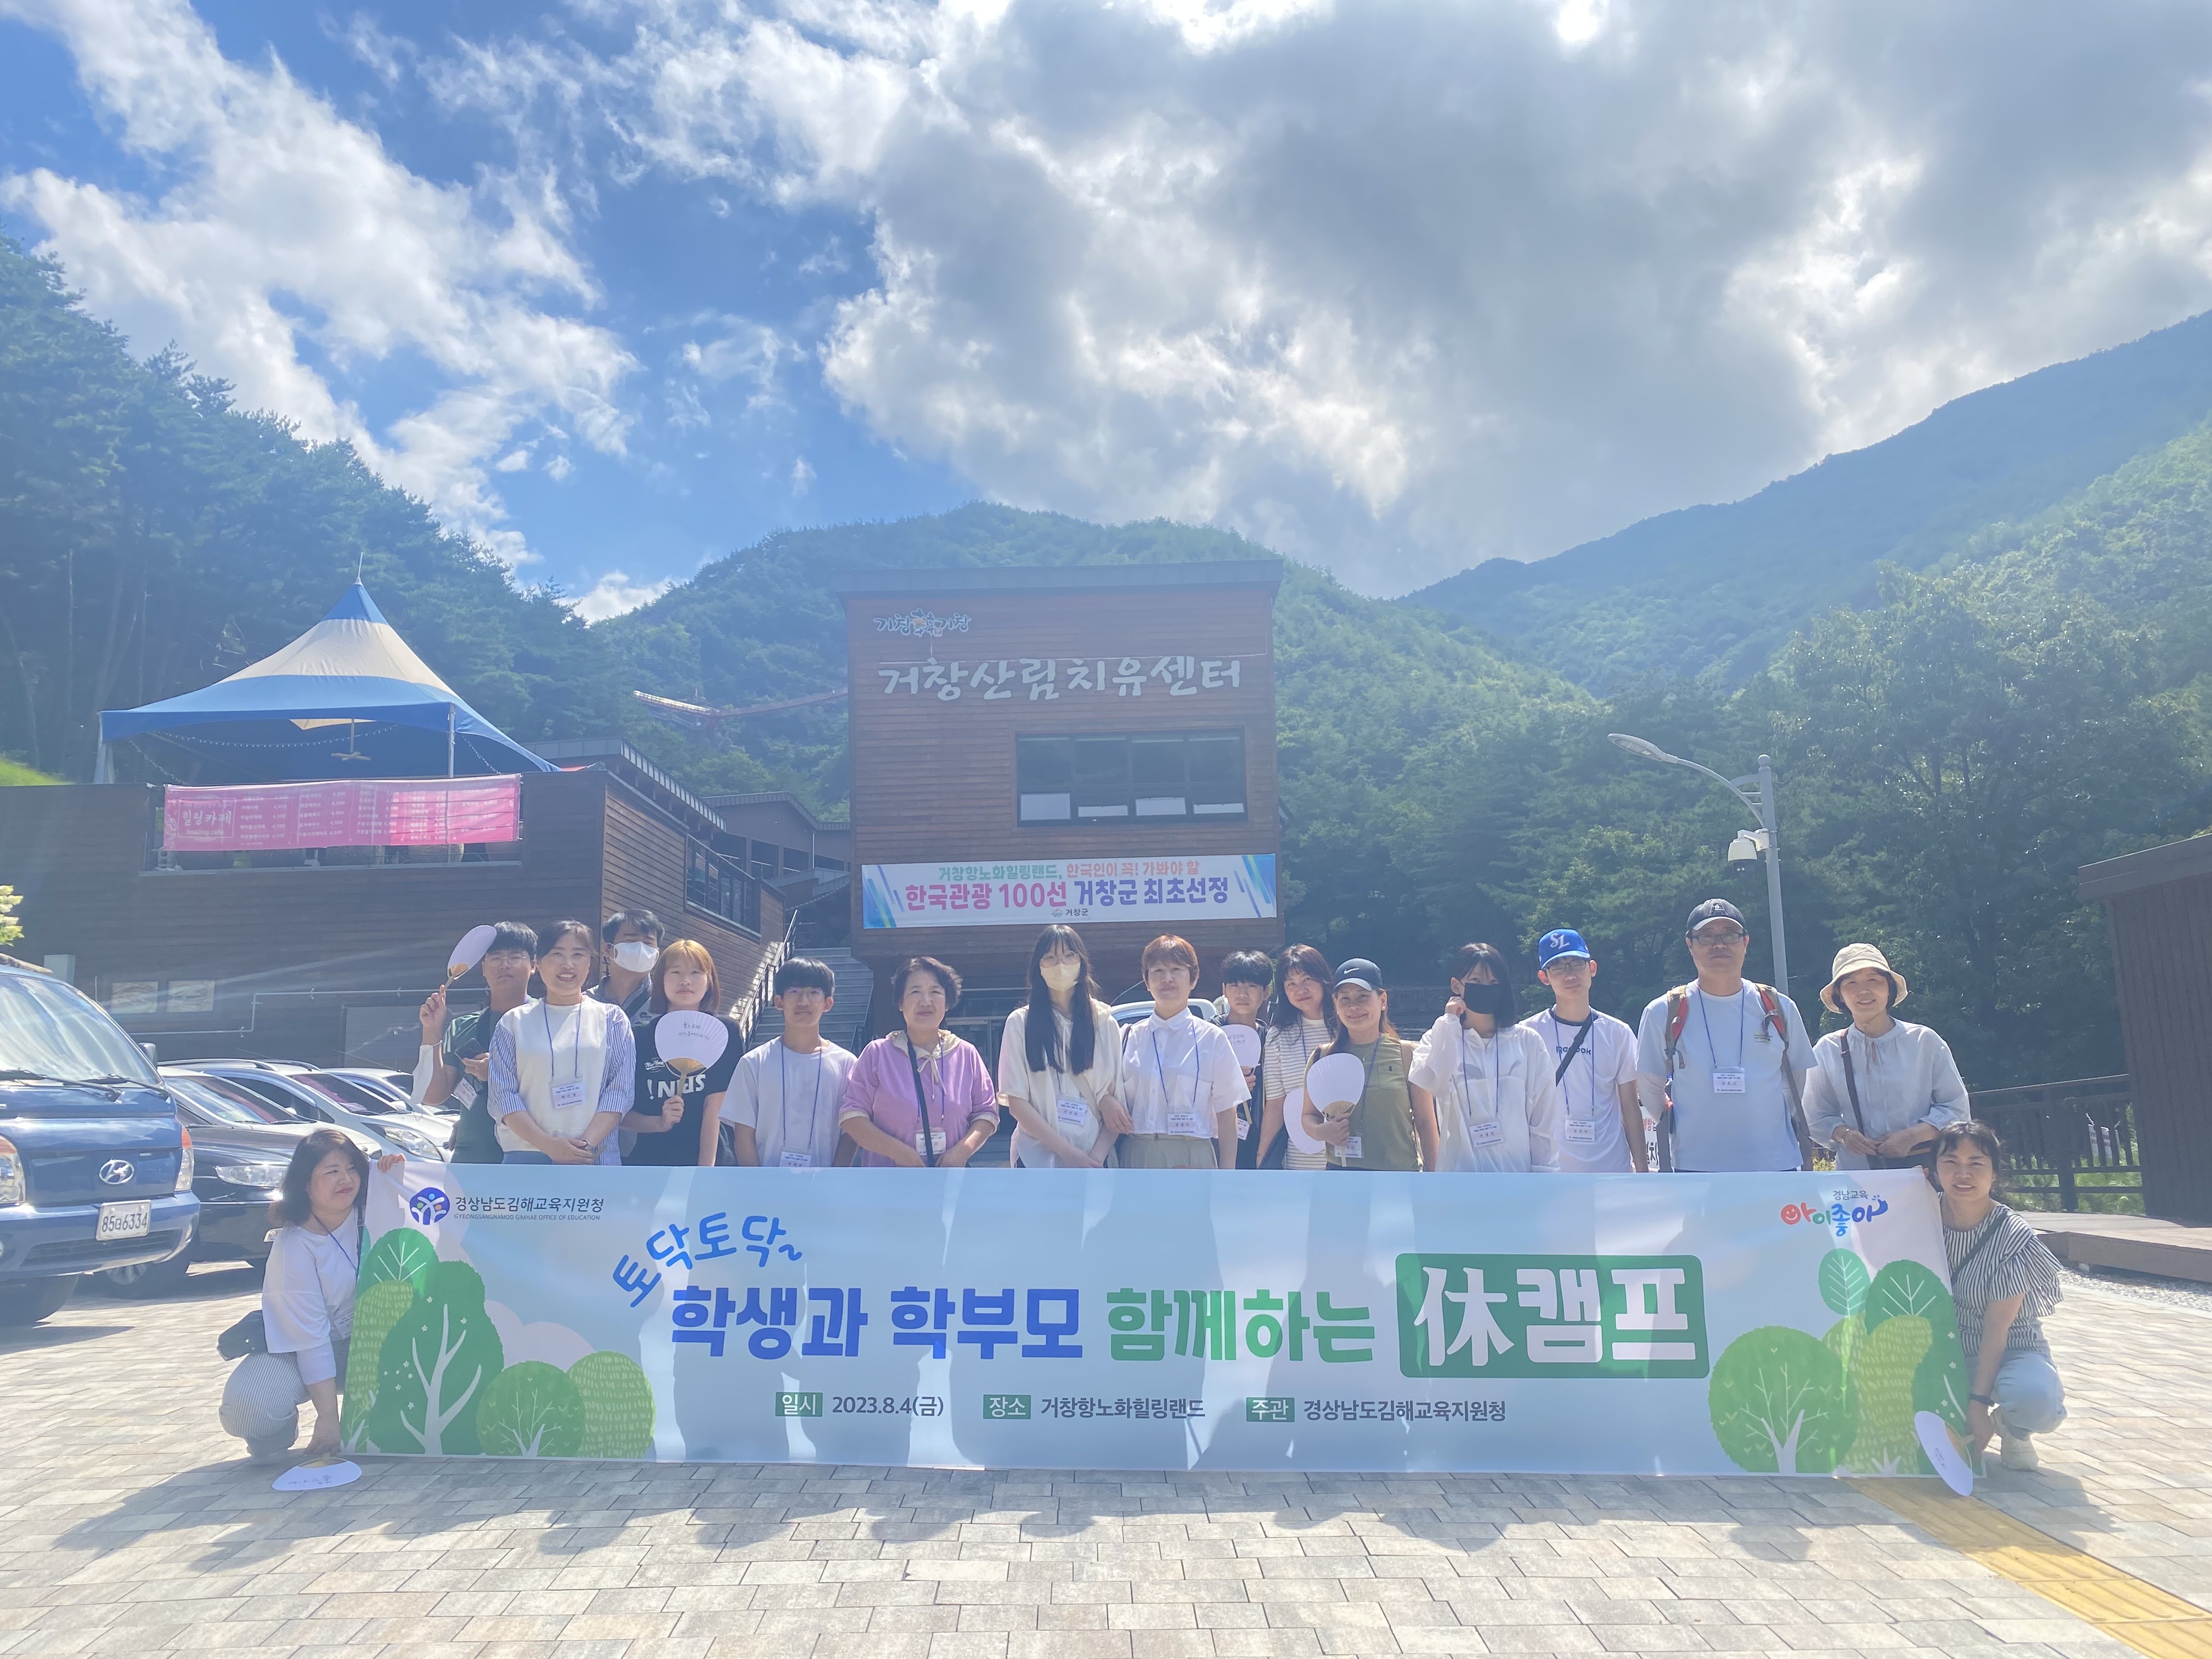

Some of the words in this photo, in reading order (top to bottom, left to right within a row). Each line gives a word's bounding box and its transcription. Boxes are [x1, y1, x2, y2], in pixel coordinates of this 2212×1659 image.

[878, 656, 1240, 701] 거창산림치유센터
[183, 810, 232, 826] 힐링카페
[939, 864, 1062, 882] 거창항노화힐링랜드,
[1067, 862, 1118, 878] 한국인이
[1121, 862, 1139, 876] 꼭!
[1142, 861, 1184, 876] 가봐야
[1187, 860, 1200, 875] 할
[905, 883, 992, 911] 한국관광
[999, 881, 1066, 909] 100선
[1074, 878, 1137, 906] 거창군
[1144, 876, 1228, 905] 최초선정
[1065, 908, 1088, 917] 거창군
[455, 1197, 604, 1212] 경상남도김해교육지원청
[1833, 1190, 1868, 1200] 경남교육
[1780, 1199, 1888, 1237] 아이좋아
[672, 1285, 868, 1360] 학생과
[891, 1286, 1083, 1359] 학부모
[1106, 1288, 1375, 1363] 함께하는
[1413, 1266, 1696, 1367] 休캠프
[781, 1393, 817, 1417] 일시
[832, 1396, 944, 1418] 2023.8.4(금)
[989, 1396, 1026, 1418] 장소
[1041, 1397, 1206, 1420] 거창항노화힐링랜드
[1251, 1400, 1289, 1421] 주관
[1304, 1400, 1506, 1421] 경상남도김해교육지원청
